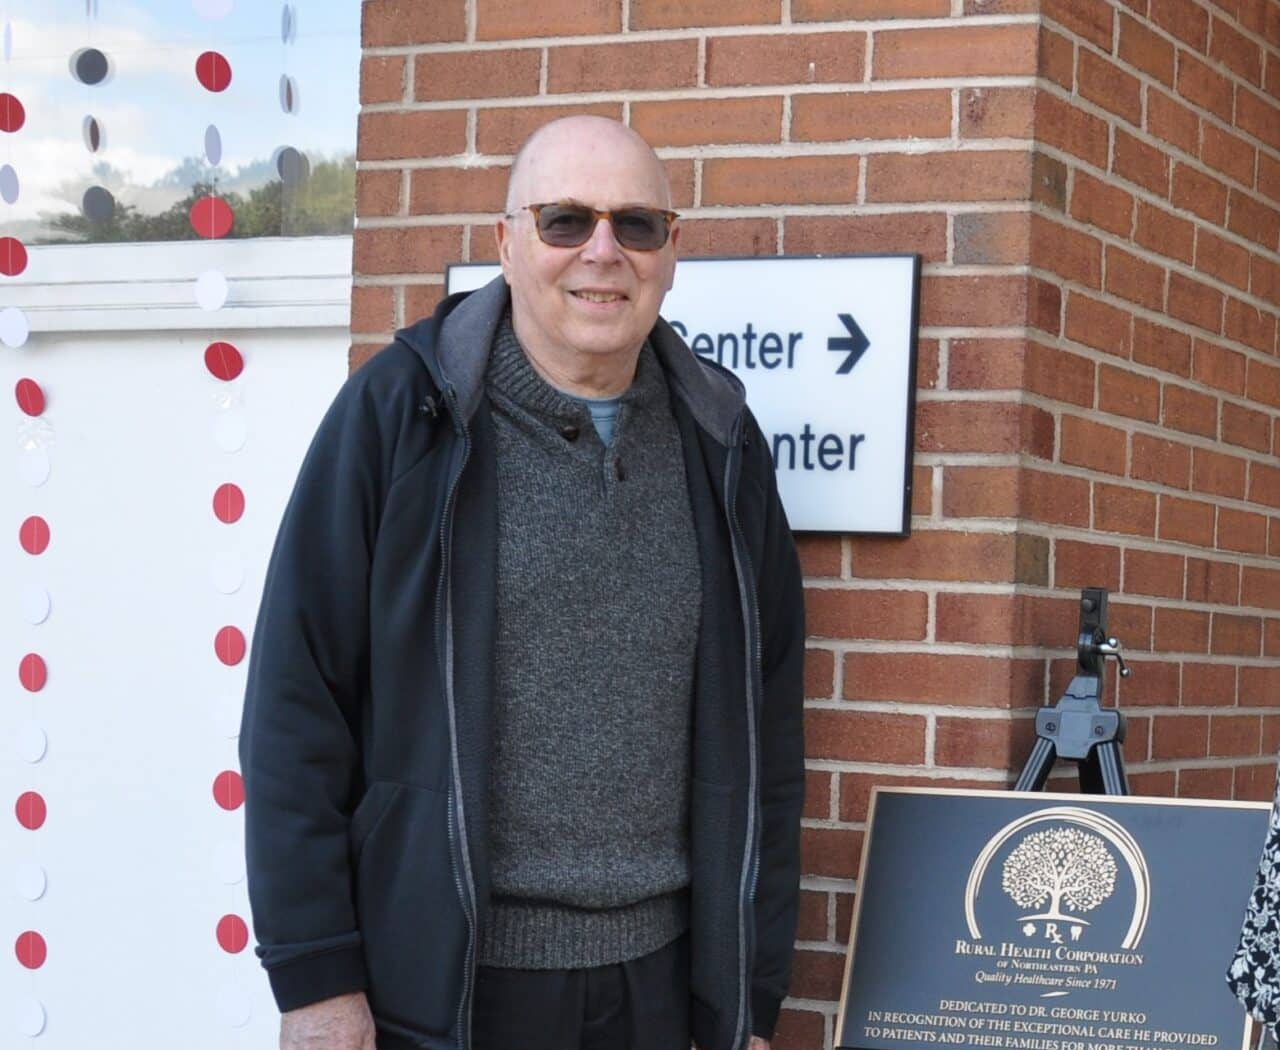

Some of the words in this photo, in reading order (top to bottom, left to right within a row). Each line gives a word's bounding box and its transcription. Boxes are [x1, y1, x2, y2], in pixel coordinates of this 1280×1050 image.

[772, 423, 866, 472] nter
[975, 970, 1012, 985] Quality
[1013, 972, 1063, 986] Healthcare
[1065, 976, 1091, 988] Since
[1093, 977, 1117, 990] 1971
[1084, 964, 1098, 974] PA
[939, 999, 1008, 1014] DEDICATED
[1009, 1005, 1027, 1017] TO
[1028, 1006, 1048, 1017] DR.
[1051, 1007, 1101, 1021] GEORGE
[1102, 1011, 1147, 1024] YURKO
[864, 1026, 881, 1038] TO
[882, 1028, 936, 1042] PATIENTS
[937, 1032, 965, 1044] AND
[967, 1034, 1003, 1047] THEIR
[1005, 1036, 1059, 1050] FAMILIES
[868, 1010, 881, 1021] IN
[884, 1012, 967, 1028] RECOGNITION
[968, 1018, 985, 1029] OF
[987, 1019, 1011, 1031] THE
[1014, 1020, 1096, 1038] EXCEPTIONAL
[1098, 1027, 1132, 1040] CARE
[1133, 1029, 1151, 1041] HE
[1153, 1031, 1218, 1046] PROVIDED
